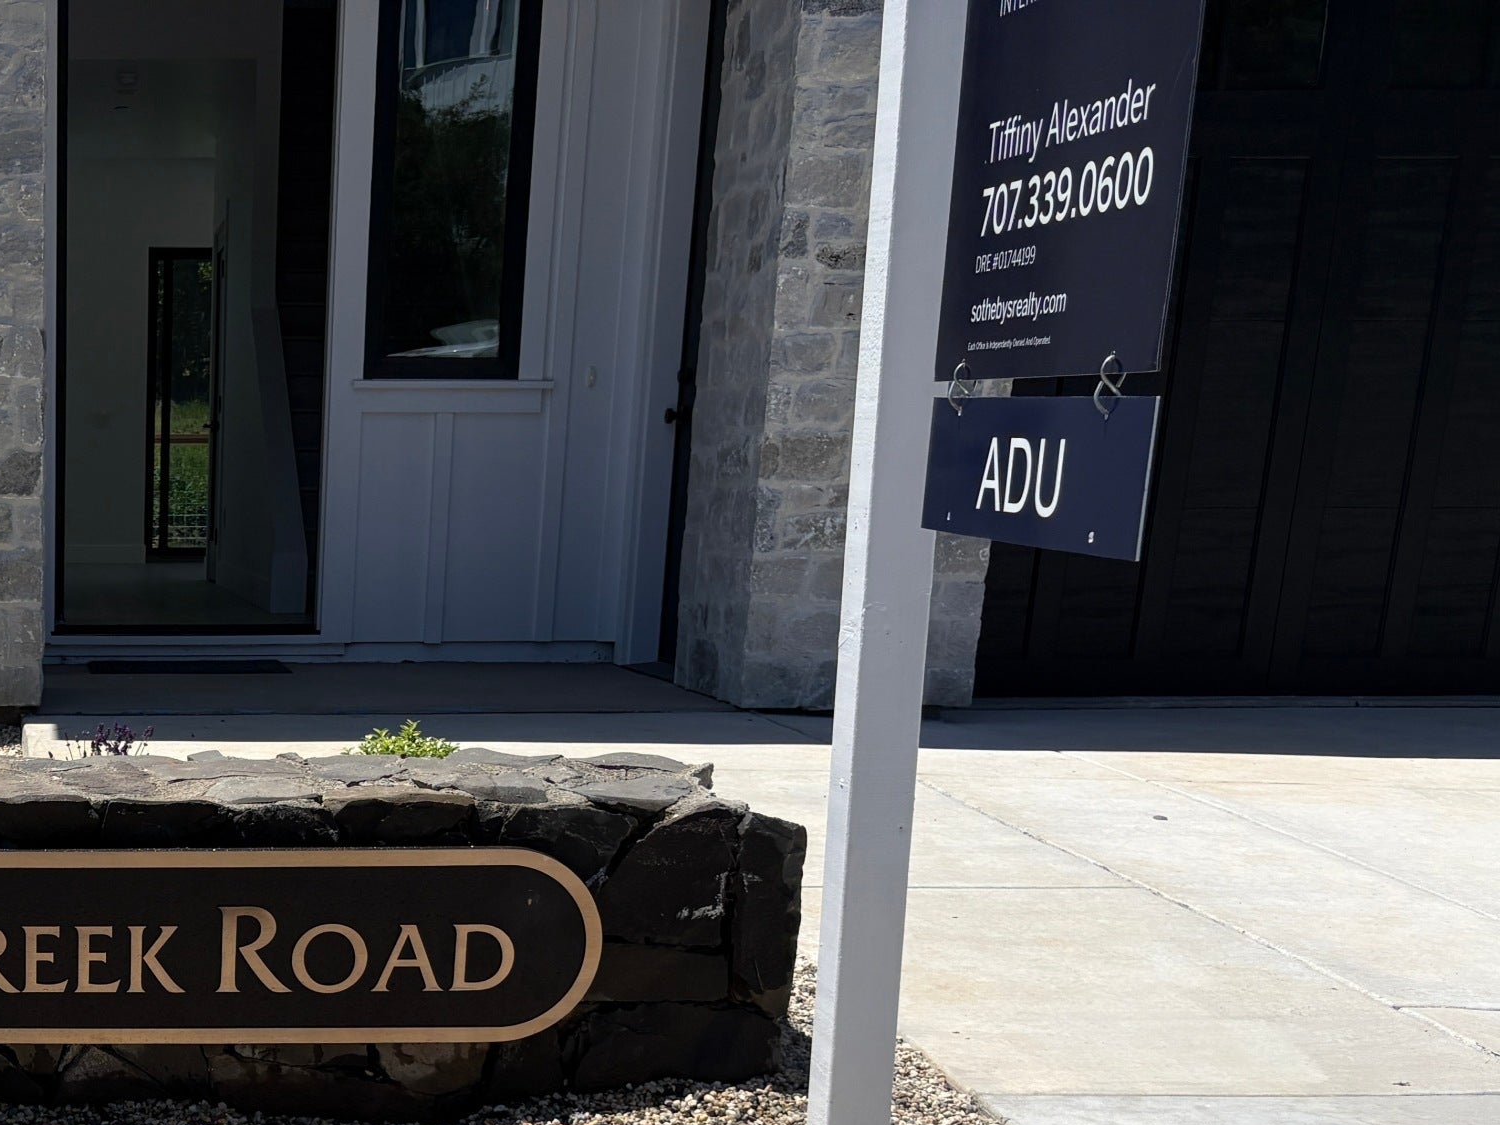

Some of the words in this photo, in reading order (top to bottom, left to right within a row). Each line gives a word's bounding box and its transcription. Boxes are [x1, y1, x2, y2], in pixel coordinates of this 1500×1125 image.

[989, 115, 1044, 164] Tiffiny
[1045, 78, 1157, 148] Alexander
[980, 146, 1154, 238] 707.339.0600
[975, 253, 992, 274] DRE
[992, 245, 1036, 270] #01744199
[970, 291, 1067, 325] sothebysrealty.com
[975, 436, 1066, 518] ADU
[215, 905, 515, 994] ROAD
